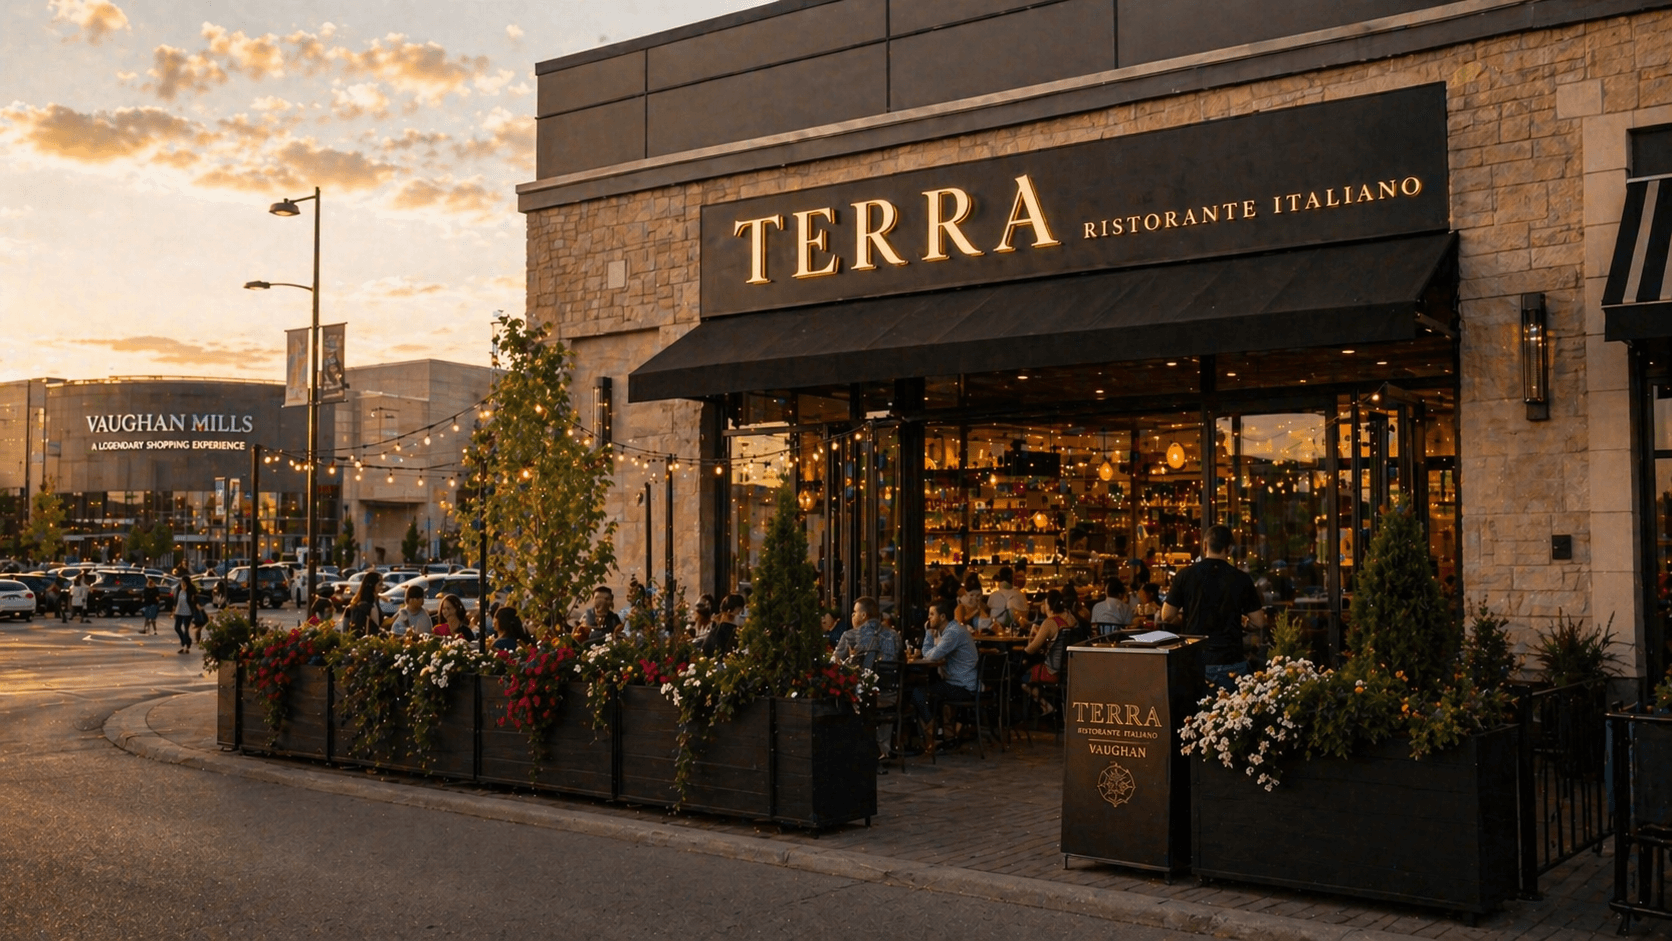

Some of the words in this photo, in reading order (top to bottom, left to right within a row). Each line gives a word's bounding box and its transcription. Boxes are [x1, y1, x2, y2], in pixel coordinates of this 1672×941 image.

[1083, 200, 1256, 239] RISTORANTE
[1273, 176, 1422, 214] ITALIANO
[733, 174, 1061, 285] TERRA
[86, 413, 186, 433] VAUGHAN
[191, 413, 253, 433] MILLS
[91, 442, 98, 451] A
[146, 440, 190, 450] SHOPPING
[192, 440, 246, 451] EXPERIENCE
[1072, 701, 1162, 728] TERRA
[1088, 743, 1147, 758] VAUGHAN
